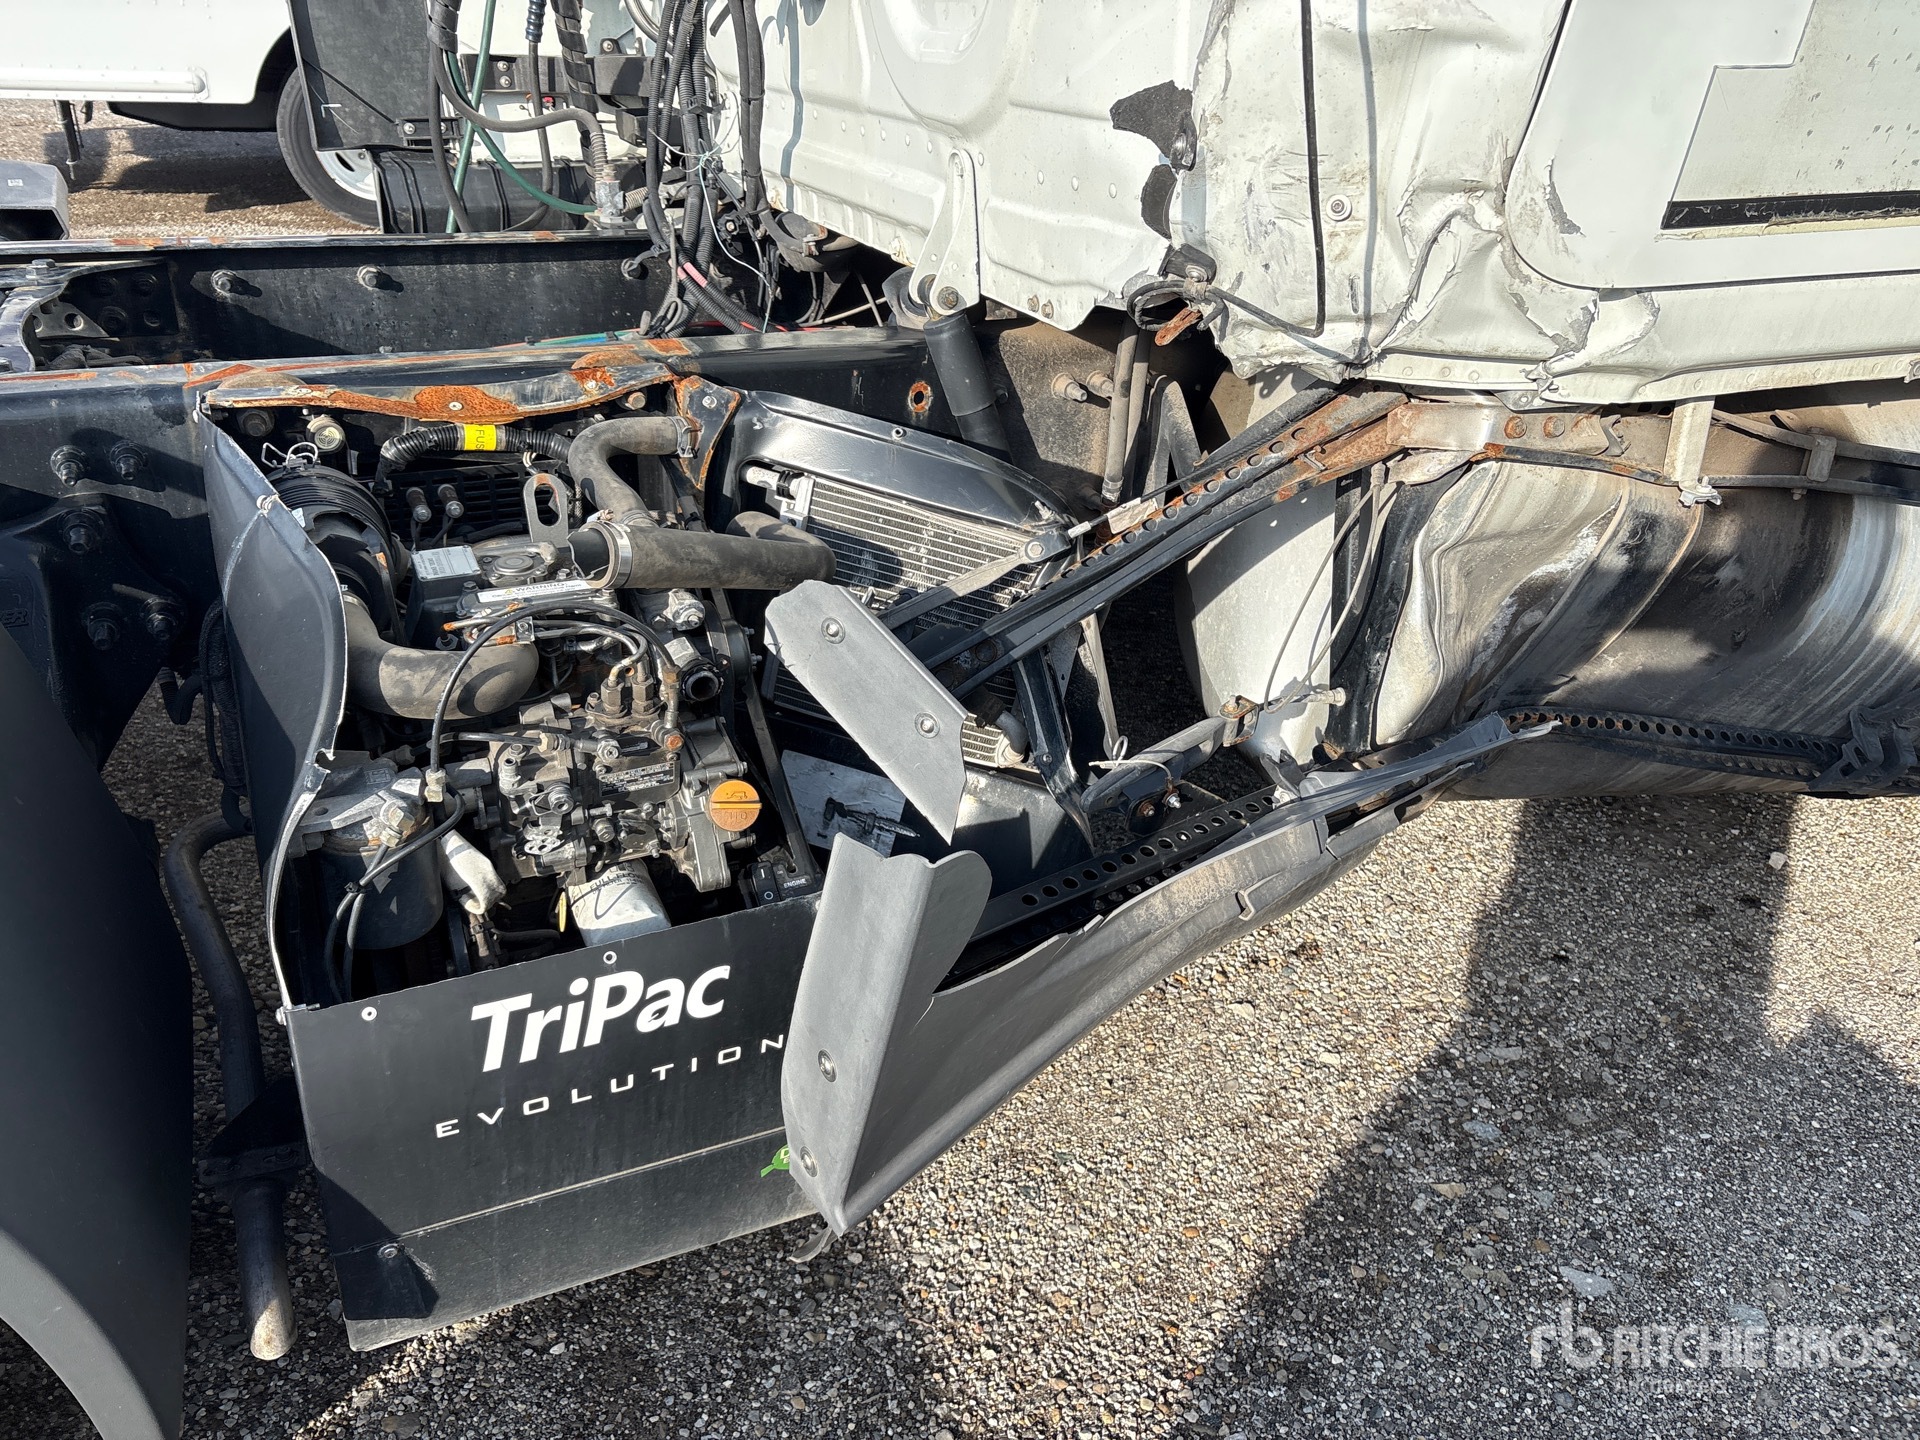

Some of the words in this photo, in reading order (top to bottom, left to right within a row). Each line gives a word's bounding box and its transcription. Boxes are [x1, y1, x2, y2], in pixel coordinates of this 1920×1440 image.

[474, 429, 486, 451] FUS
[783, 878, 807, 889] ENGINE
[470, 965, 731, 1073] TriPac
[435, 1034, 784, 1138] EVOLUTION
